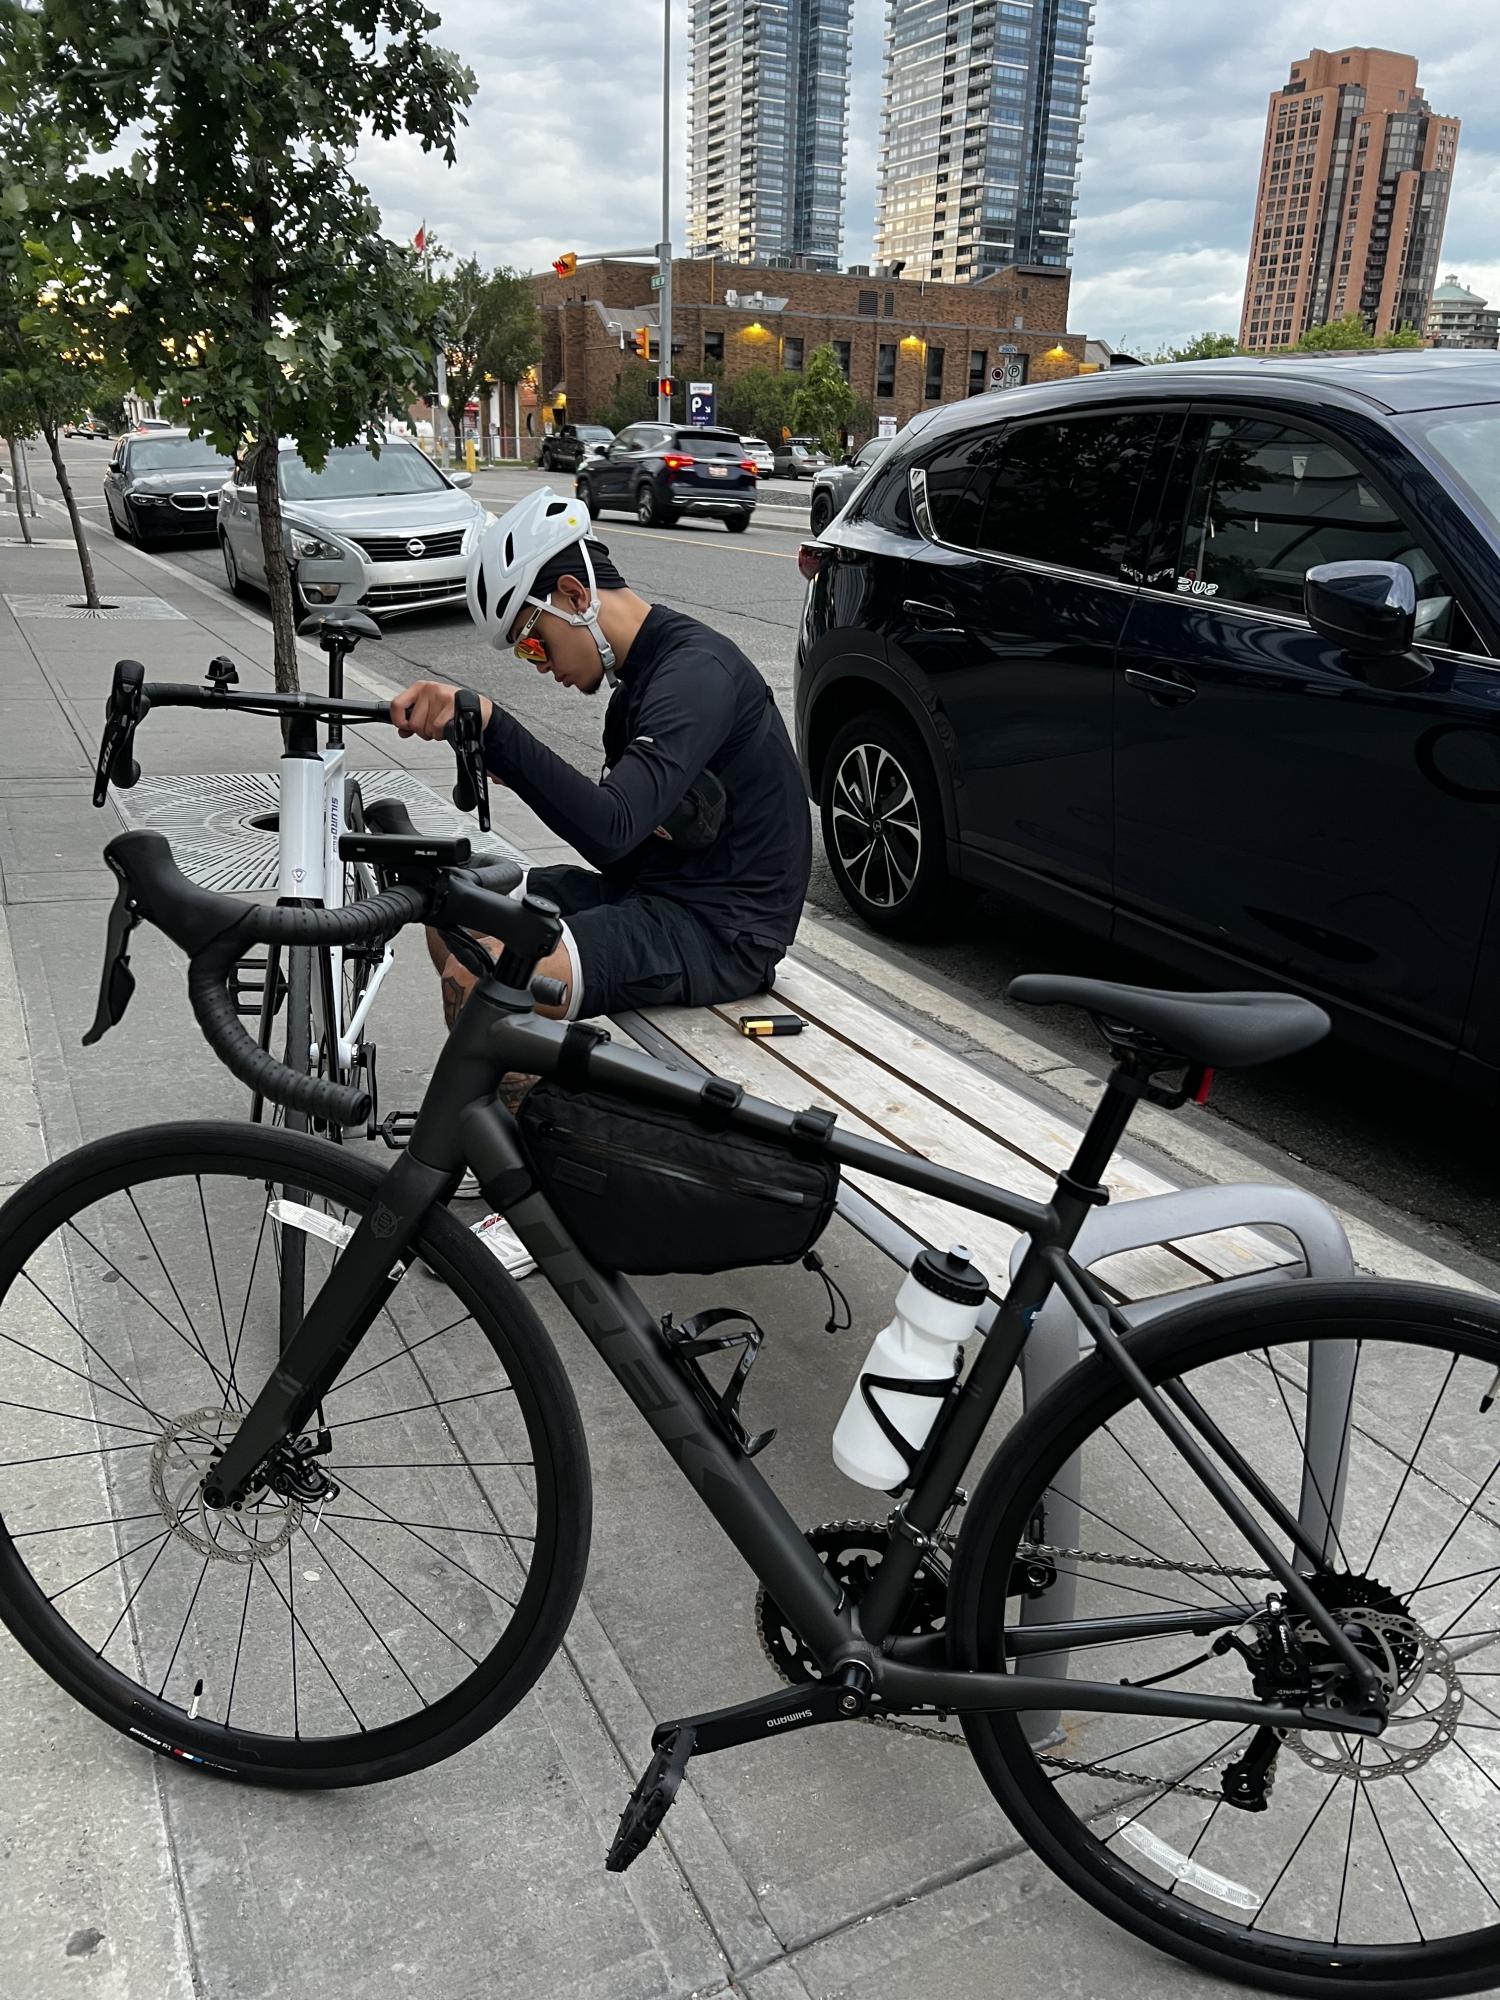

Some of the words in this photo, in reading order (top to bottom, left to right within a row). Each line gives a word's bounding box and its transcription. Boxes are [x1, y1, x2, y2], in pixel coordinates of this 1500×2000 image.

[691, 397, 702, 413] P
[330, 797, 339, 836] SILURO
[505, 1192, 740, 1488] TREK
[766, 1709, 813, 1728] SHIMANO
